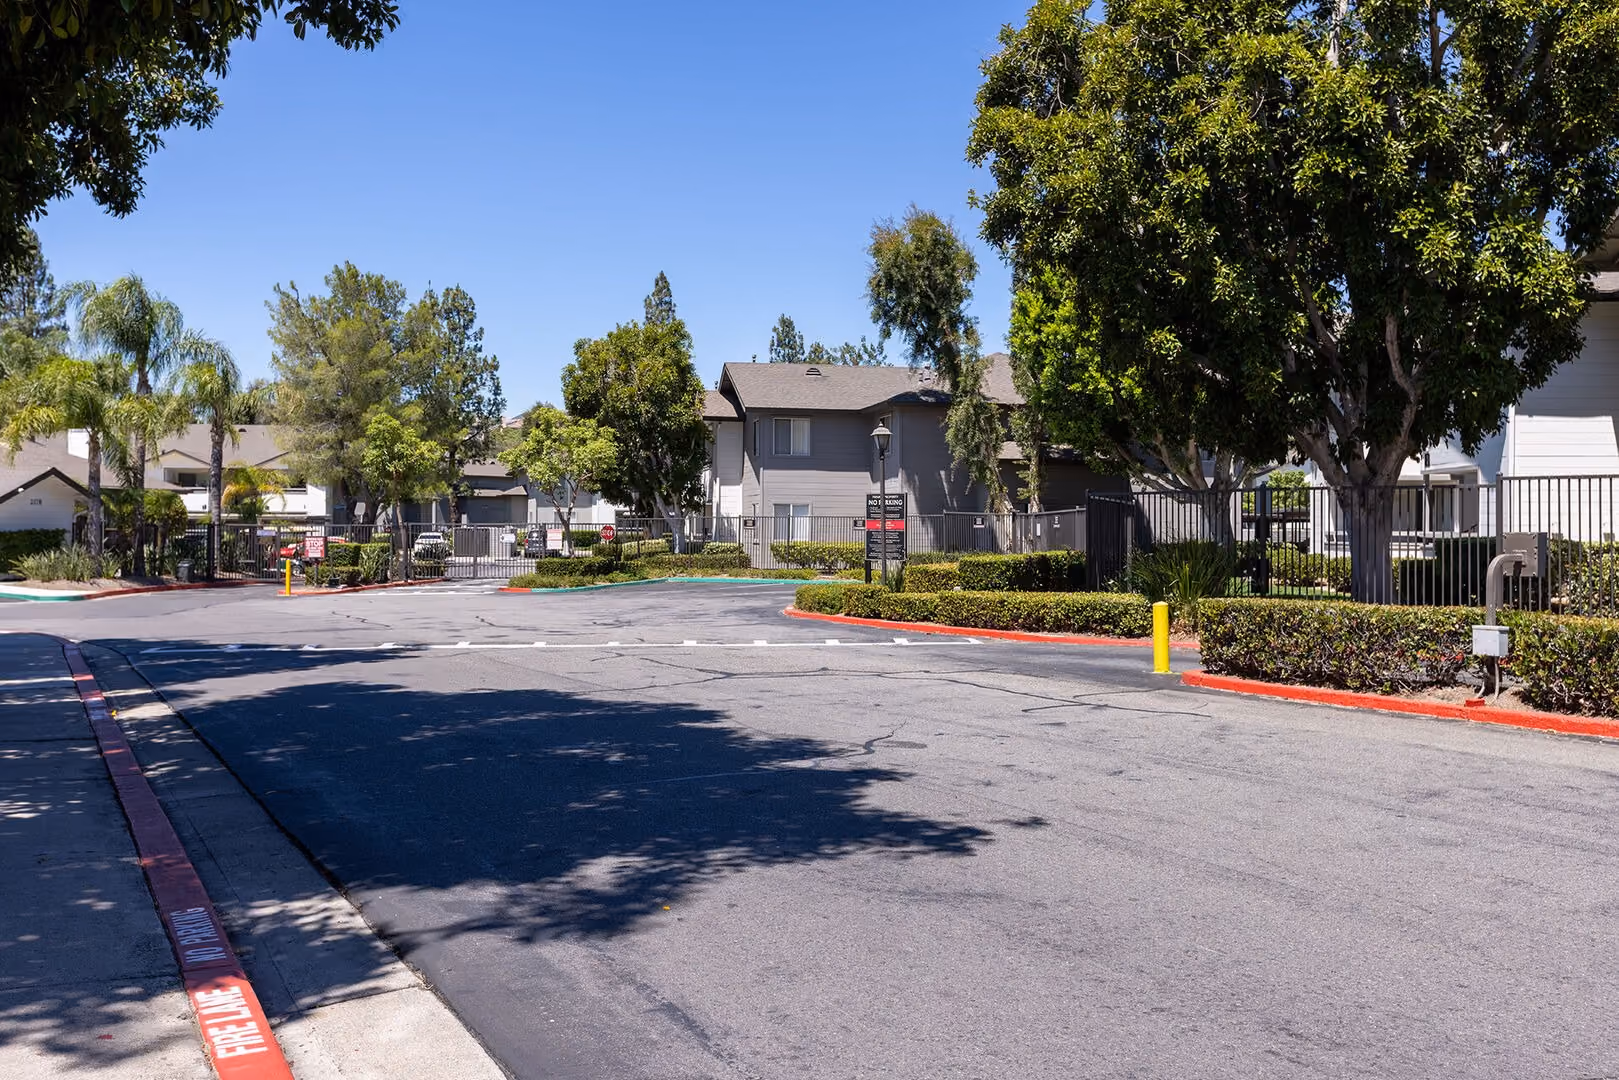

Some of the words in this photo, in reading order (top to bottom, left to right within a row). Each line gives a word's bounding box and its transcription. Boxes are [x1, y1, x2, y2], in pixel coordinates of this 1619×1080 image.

[170, 907, 220, 945] PARKING
[184, 946, 227, 963] NO
[195, 986, 252, 1024] LANE
[208, 1021, 268, 1059] FIRE
